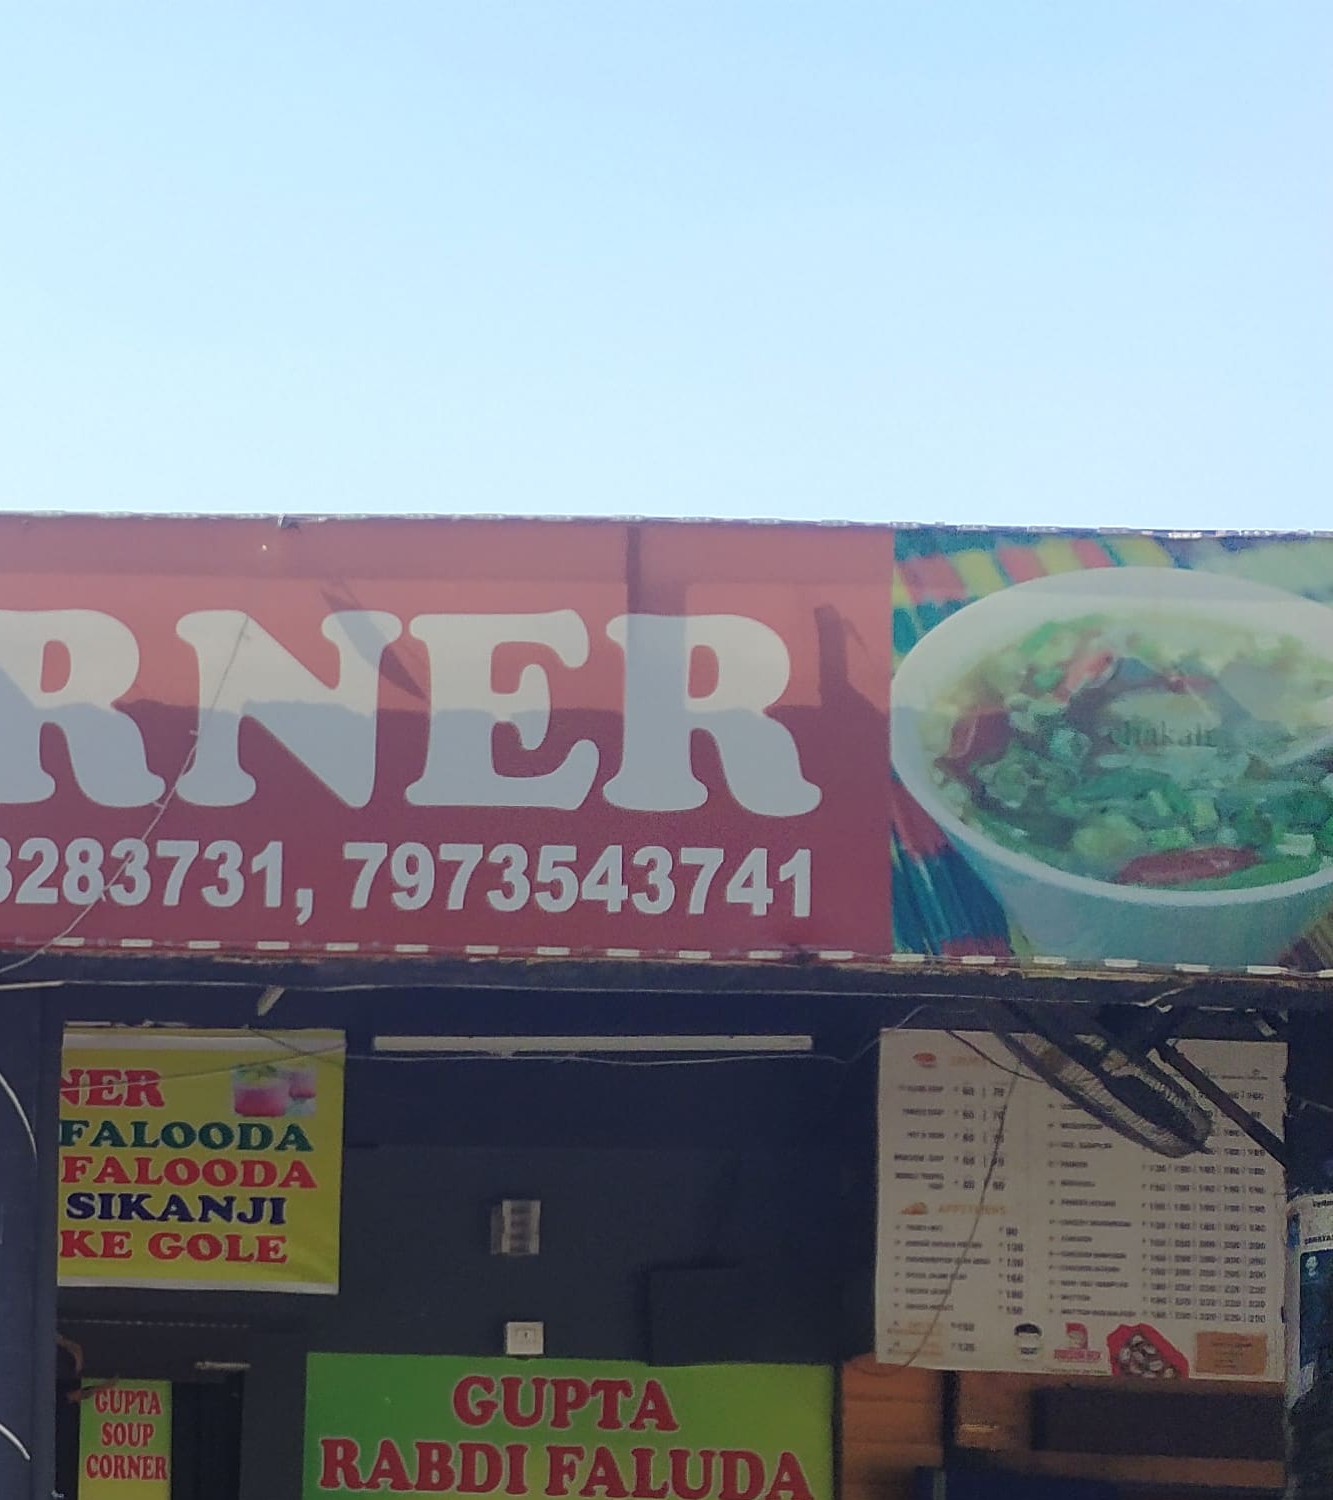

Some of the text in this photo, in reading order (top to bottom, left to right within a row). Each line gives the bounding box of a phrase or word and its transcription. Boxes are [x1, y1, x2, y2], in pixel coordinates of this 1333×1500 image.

[342, 842, 813, 919] 7973543741
[59, 1120, 313, 1152] FALOODA
[61, 1155, 317, 1189] FALOODA
[66, 1193, 286, 1225] SIKANJI
[60, 1231, 288, 1264] KE GOLE
[94, 1390, 161, 1416] GUPTA
[453, 1376, 678, 1432] GUPTA
[101, 1422, 154, 1448] SOUP
[86, 1453, 167, 1481] CORNER
[320, 1438, 529, 1495] RABDI
